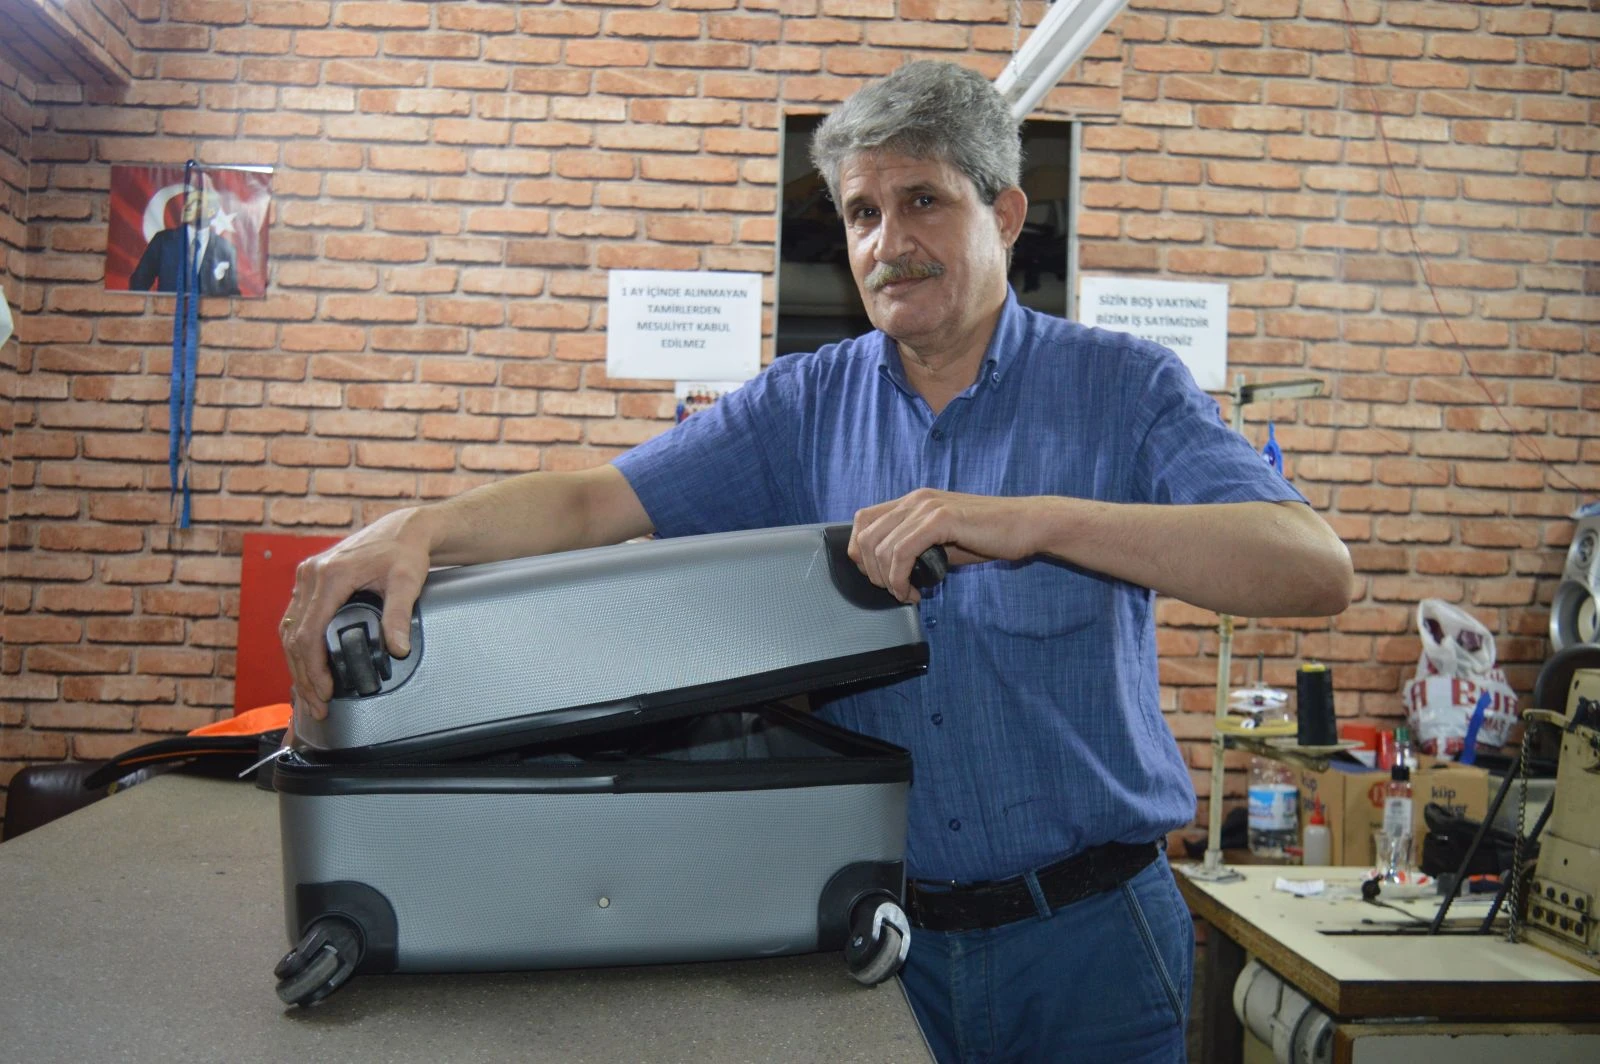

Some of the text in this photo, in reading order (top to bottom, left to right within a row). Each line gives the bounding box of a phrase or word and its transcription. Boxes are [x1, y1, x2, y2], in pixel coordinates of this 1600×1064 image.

[630, 287, 644, 297] AY
[647, 286, 681, 299] İÇİNDE
[684, 287, 748, 299] ALINMAYAN
[1099, 293, 1208, 310] SİZİN BOŞ VAKTİNİZ
[647, 303, 721, 315] TAMİRLERDEN
[1096, 312, 1128, 325] BİZİM
[637, 319, 731, 332] MESULİYET KABUL
[661, 338, 706, 349] EDİLMEZ
